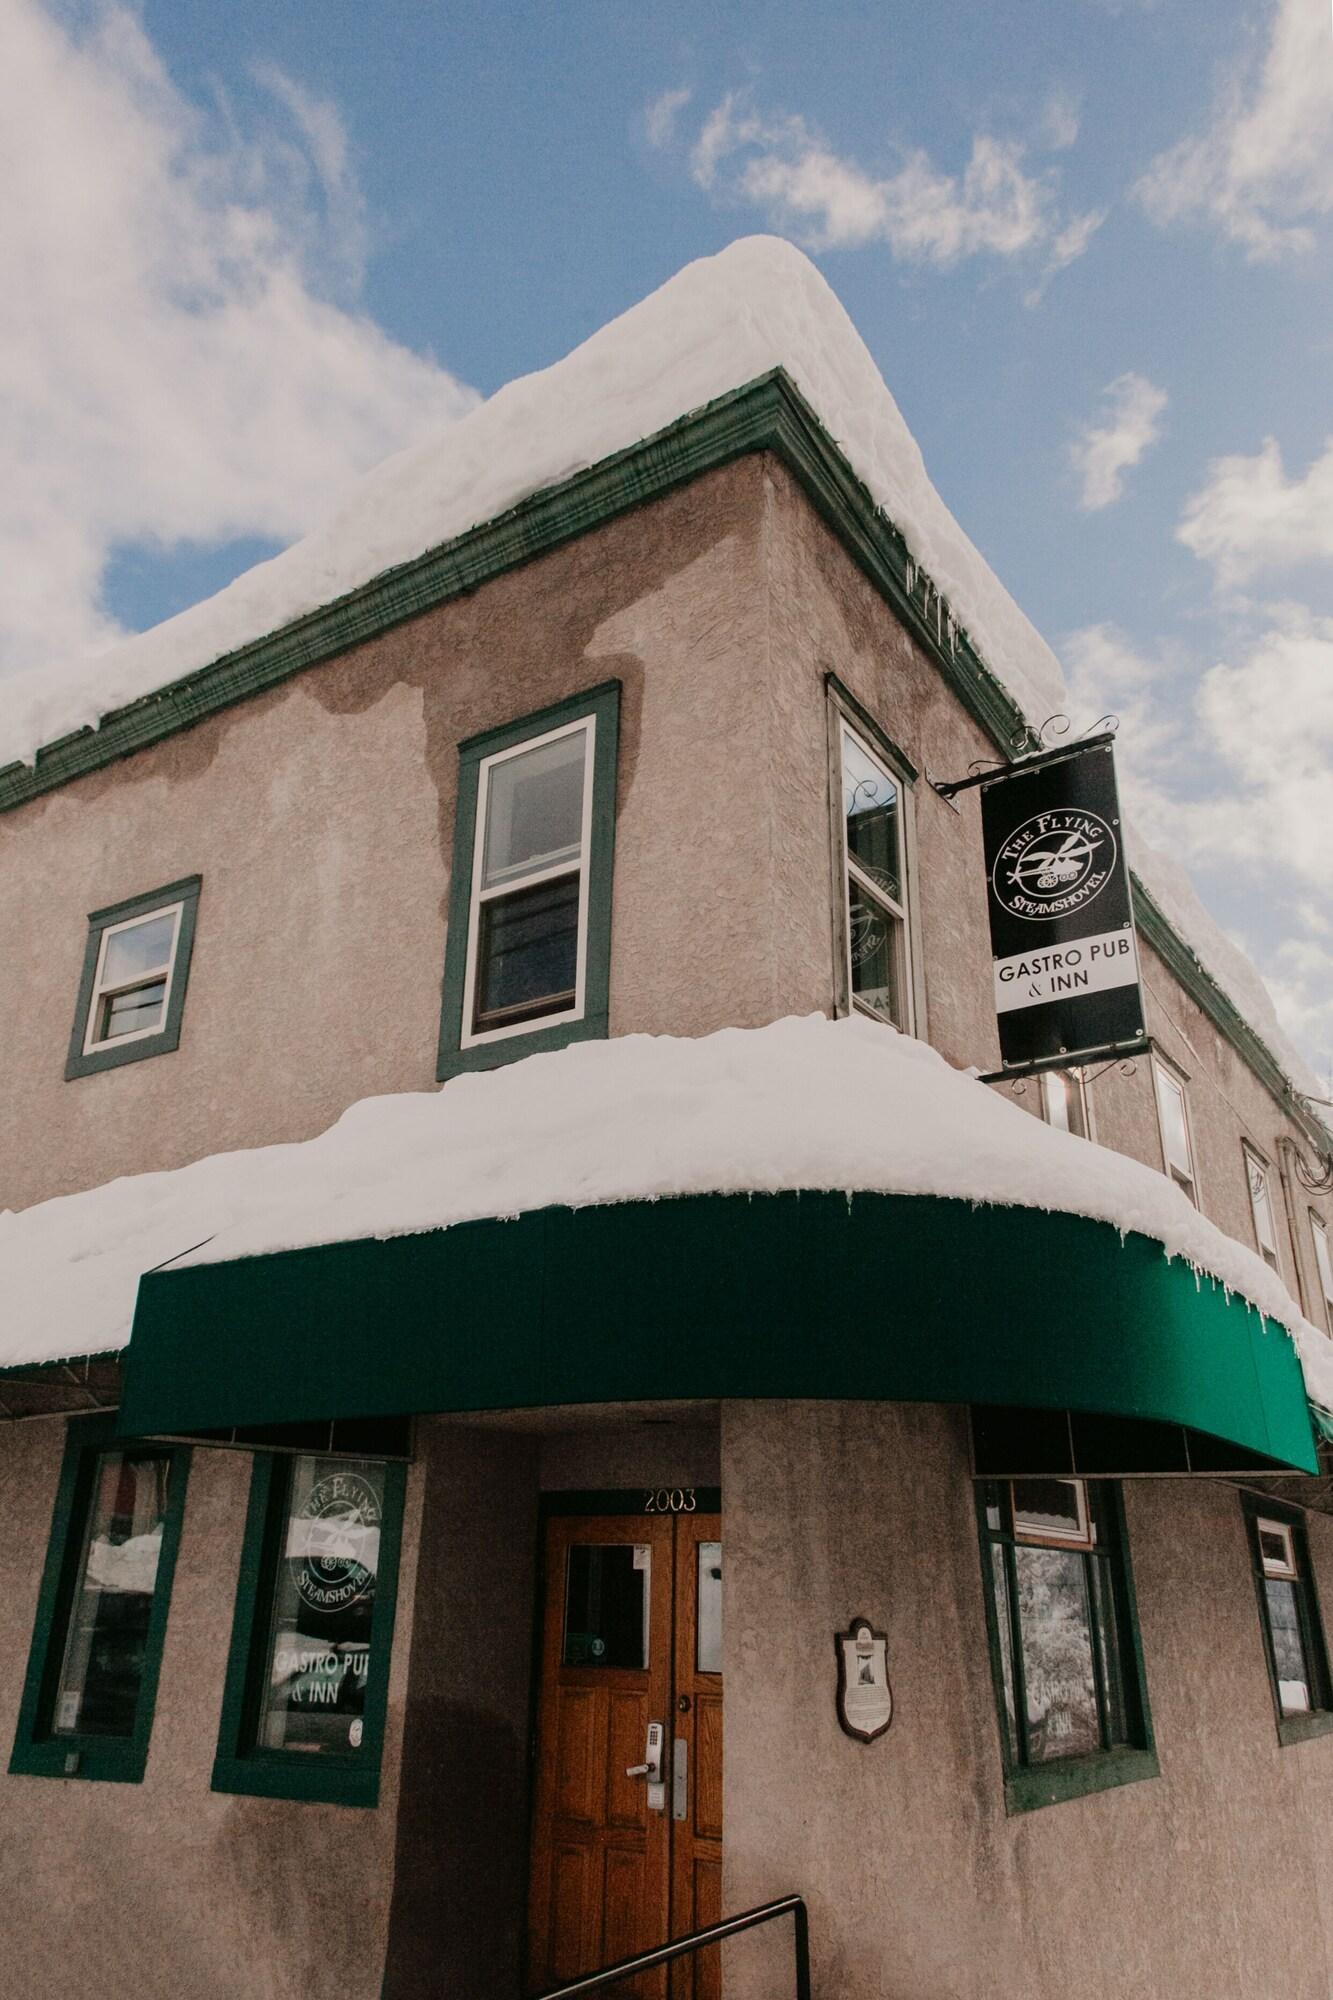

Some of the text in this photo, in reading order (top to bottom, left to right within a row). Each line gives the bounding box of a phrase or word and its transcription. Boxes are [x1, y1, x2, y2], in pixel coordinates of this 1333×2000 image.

[1002, 815, 1104, 860] THE FLYING
[1009, 871, 1106, 915] STEAMSHOVEL
[999, 939, 1130, 982] GASTRO PUB
[1028, 970, 1088, 997] & INN
[644, 1488, 697, 1512] 2003
[275, 1649, 338, 1675] GASTRO
[308, 1681, 340, 1704] INN
